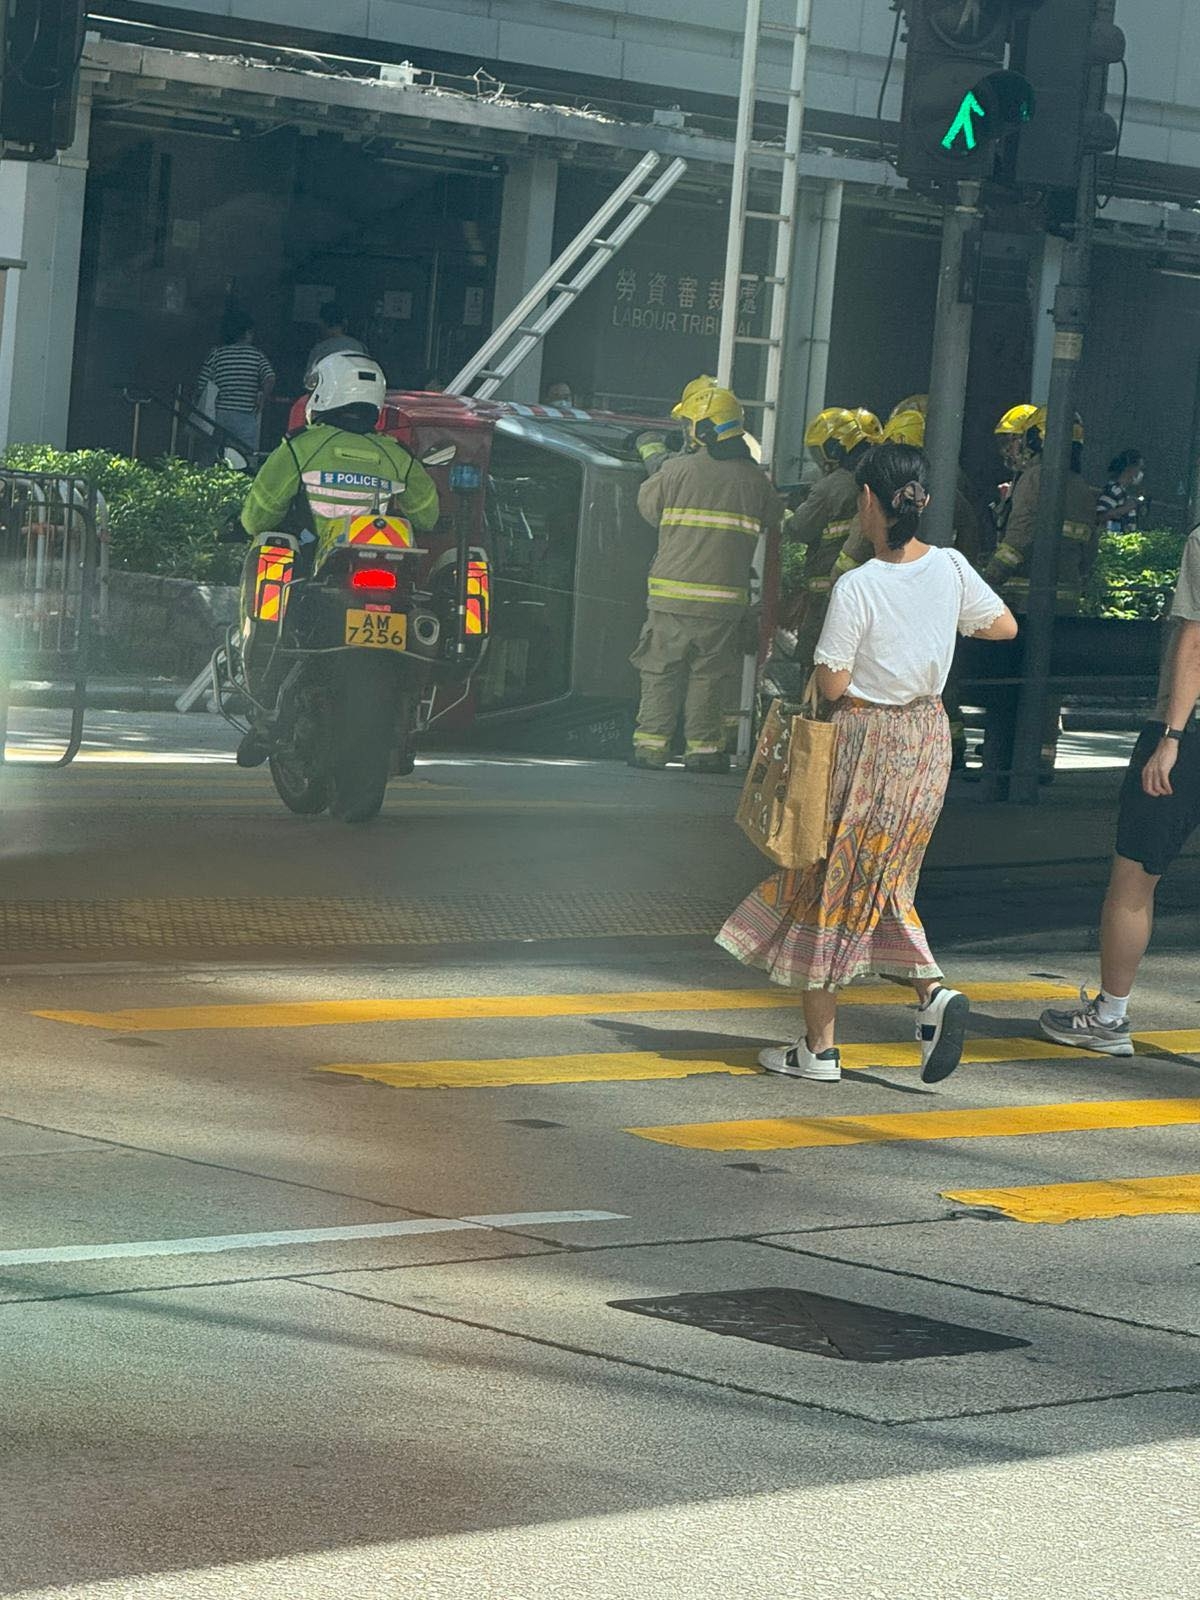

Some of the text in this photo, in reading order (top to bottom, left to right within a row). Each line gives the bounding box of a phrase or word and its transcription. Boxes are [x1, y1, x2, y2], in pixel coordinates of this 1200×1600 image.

[612, 305, 752, 337] LABOUR TRIBAL
[337, 473, 378, 487] POLICE
[363, 613, 391, 630] AM
[349, 626, 403, 646] 7256
